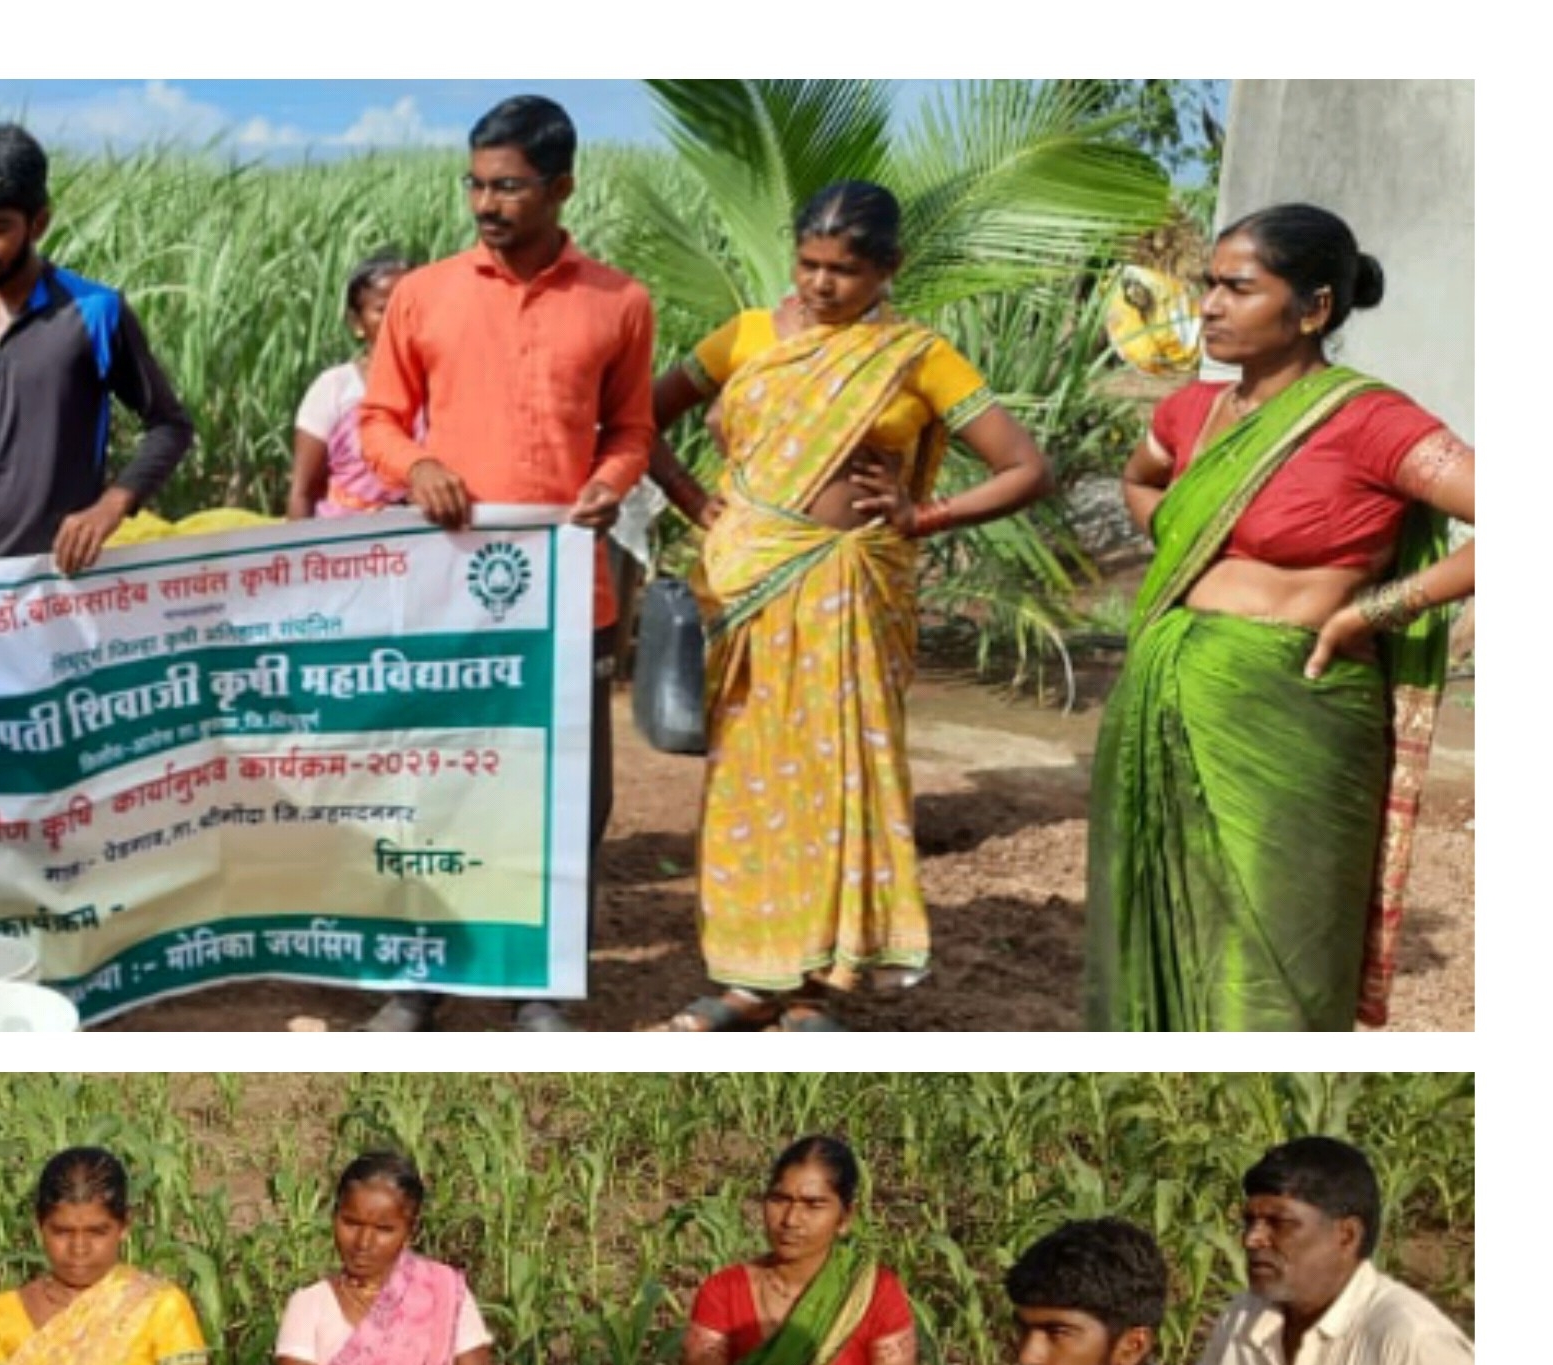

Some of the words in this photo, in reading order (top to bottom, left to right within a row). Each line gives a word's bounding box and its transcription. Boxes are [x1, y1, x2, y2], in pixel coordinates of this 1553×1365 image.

[159, 564, 230, 602] सावंत
[238, 553, 294, 599] कृषी
[301, 543, 410, 584] विद्यापीठ
[67, 661, 202, 742] शिवाजी
[208, 653, 290, 714] कृषी
[39, 793, 94, 851] कृषि
[165, 927, 256, 970] मोनिका
